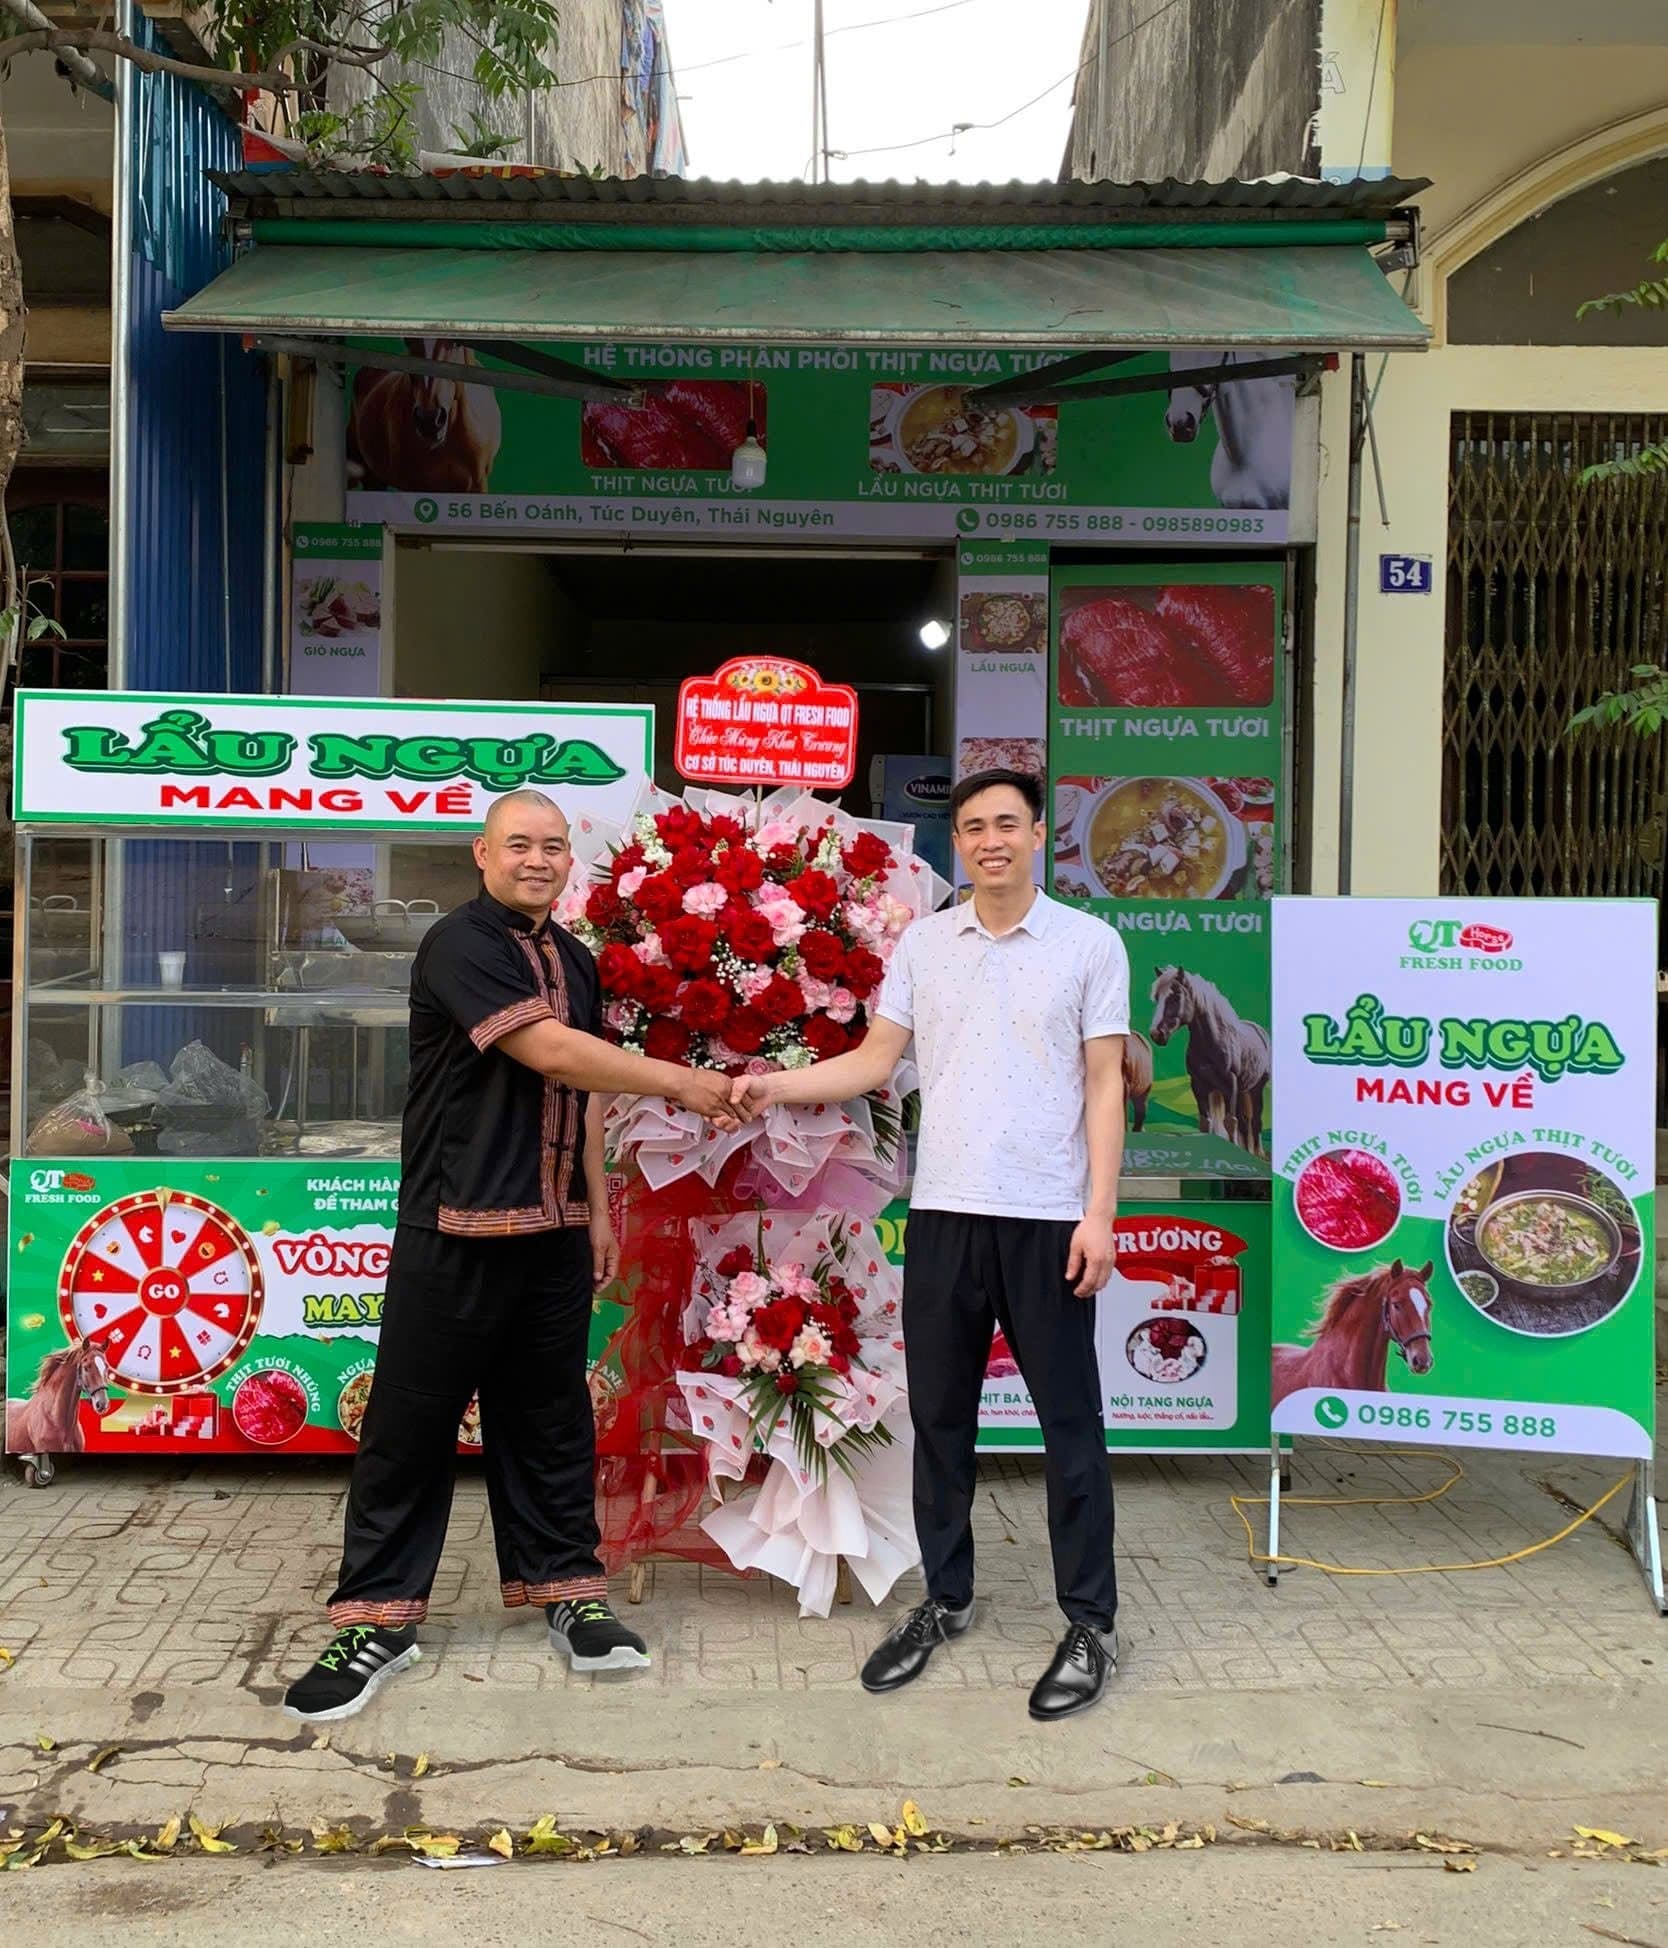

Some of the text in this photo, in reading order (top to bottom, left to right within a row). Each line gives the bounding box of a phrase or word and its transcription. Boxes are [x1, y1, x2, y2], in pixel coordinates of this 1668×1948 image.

[866, 352, 922, 376] THỊT
[930, 350, 1001, 376] NGỰA
[591, 476, 635, 495] THỊT
[642, 476, 698, 496] NGỰA
[904, 480, 960, 501] NGỰA
[968, 483, 1013, 502] THỊT
[1020, 483, 1068, 500] TƯƠI
[448, 500, 834, 527] 56 Bến Oánh, Túc Duyên, Thái Nguyên
[986, 513, 1037, 529] 0986
[1045, 514, 1079, 530] 755
[1087, 515, 1124, 531] 888
[1143, 516, 1264, 533] 0985890983
[977, 553, 1003, 563] 0986
[1007, 553, 1025, 563] 755
[1389, 560, 1422, 587] 54
[793, 704, 825, 726] FRESH
[825, 706, 850, 728] FOOD
[1060, 716, 1269, 741] THỊT NGỰA TƯƠI
[61, 709, 626, 793] LẨU NGỰA
[803, 760, 845, 779] NGUYÊN
[160, 782, 472, 814] MANG VỀ
[1117, 910, 1192, 936] NGỰA
[1198, 912, 1262, 934] TƯƠI
[1408, 919, 1463, 953] QT
[1400, 956, 1523, 971] FRESH FOOD
[1303, 993, 1625, 1083] LẨU NGỰA
[1356, 1072, 1534, 1109] MANG VỀ
[1283, 1136, 1322, 1175] THỊT
[1327, 1129, 1389, 1156] NGỰA
[1433, 1128, 1639, 1201] LẨU NGỰA THỊT TƯƠI
[307, 1175, 366, 1193] KHÁCH
[24, 1193, 102, 1204] FRESH FOOD
[313, 1193, 337, 1211] ĐỂ
[339, 1198, 388, 1211] THAM
[1113, 1226, 1224, 1254] RƯƠNG
[273, 1233, 391, 1279] VÒNG
[149, 1284, 180, 1299] GO
[303, 1292, 384, 1329] MAY
[255, 1355, 290, 1371] TƯƠI
[292, 1364, 321, 1413] NHÚNG
[1003, 1392, 1022, 1404] BA
[1137, 1395, 1173, 1410] TẠNG
[1175, 1394, 1214, 1410] NGỰA
[1358, 1403, 1556, 1438] 0986 755 888
